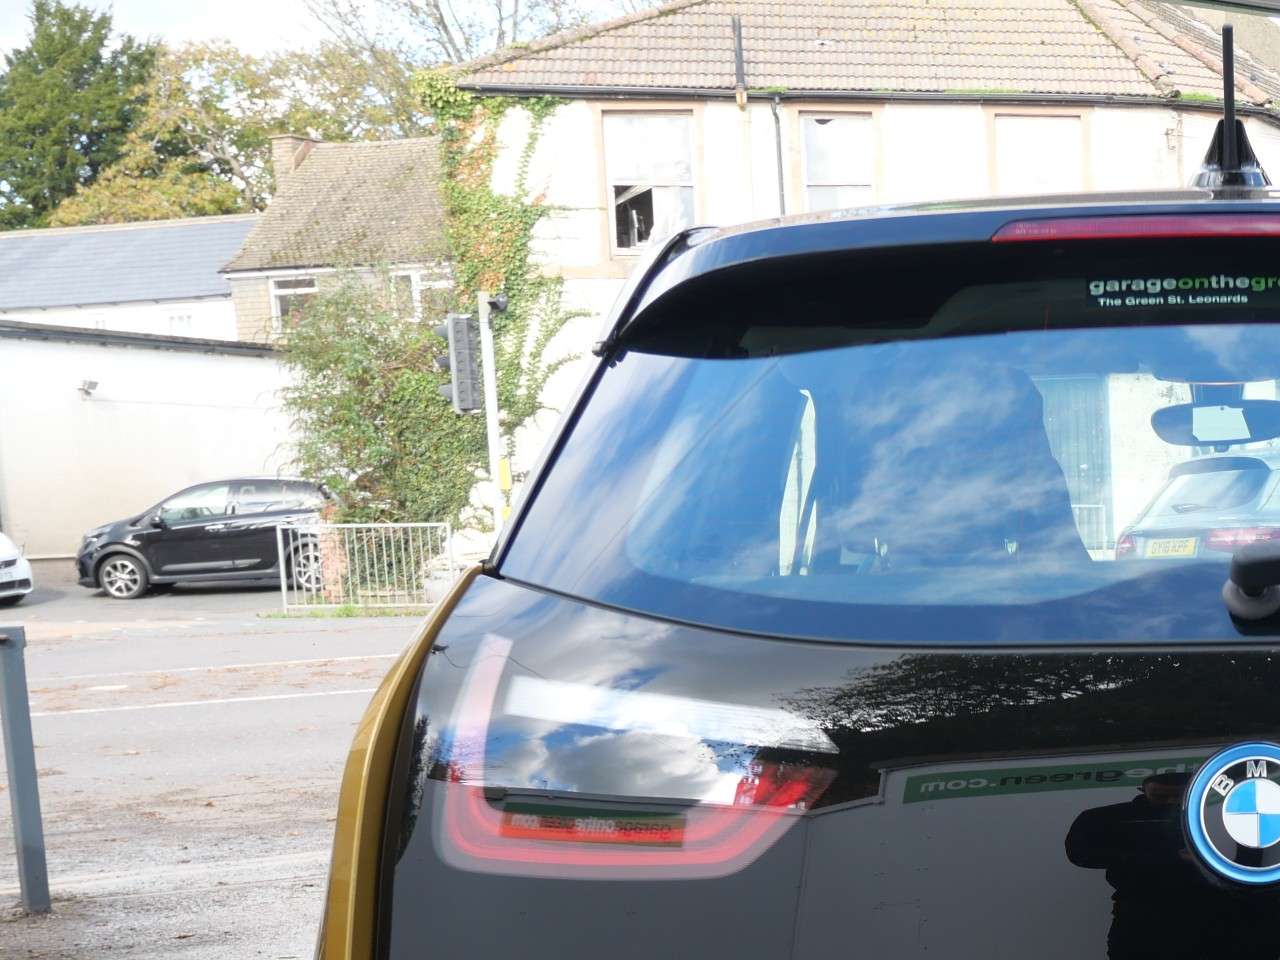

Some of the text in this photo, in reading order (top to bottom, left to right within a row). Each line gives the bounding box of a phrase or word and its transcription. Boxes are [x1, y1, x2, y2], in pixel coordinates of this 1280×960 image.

[1098, 293, 1249, 308] The Green St. Leonards
